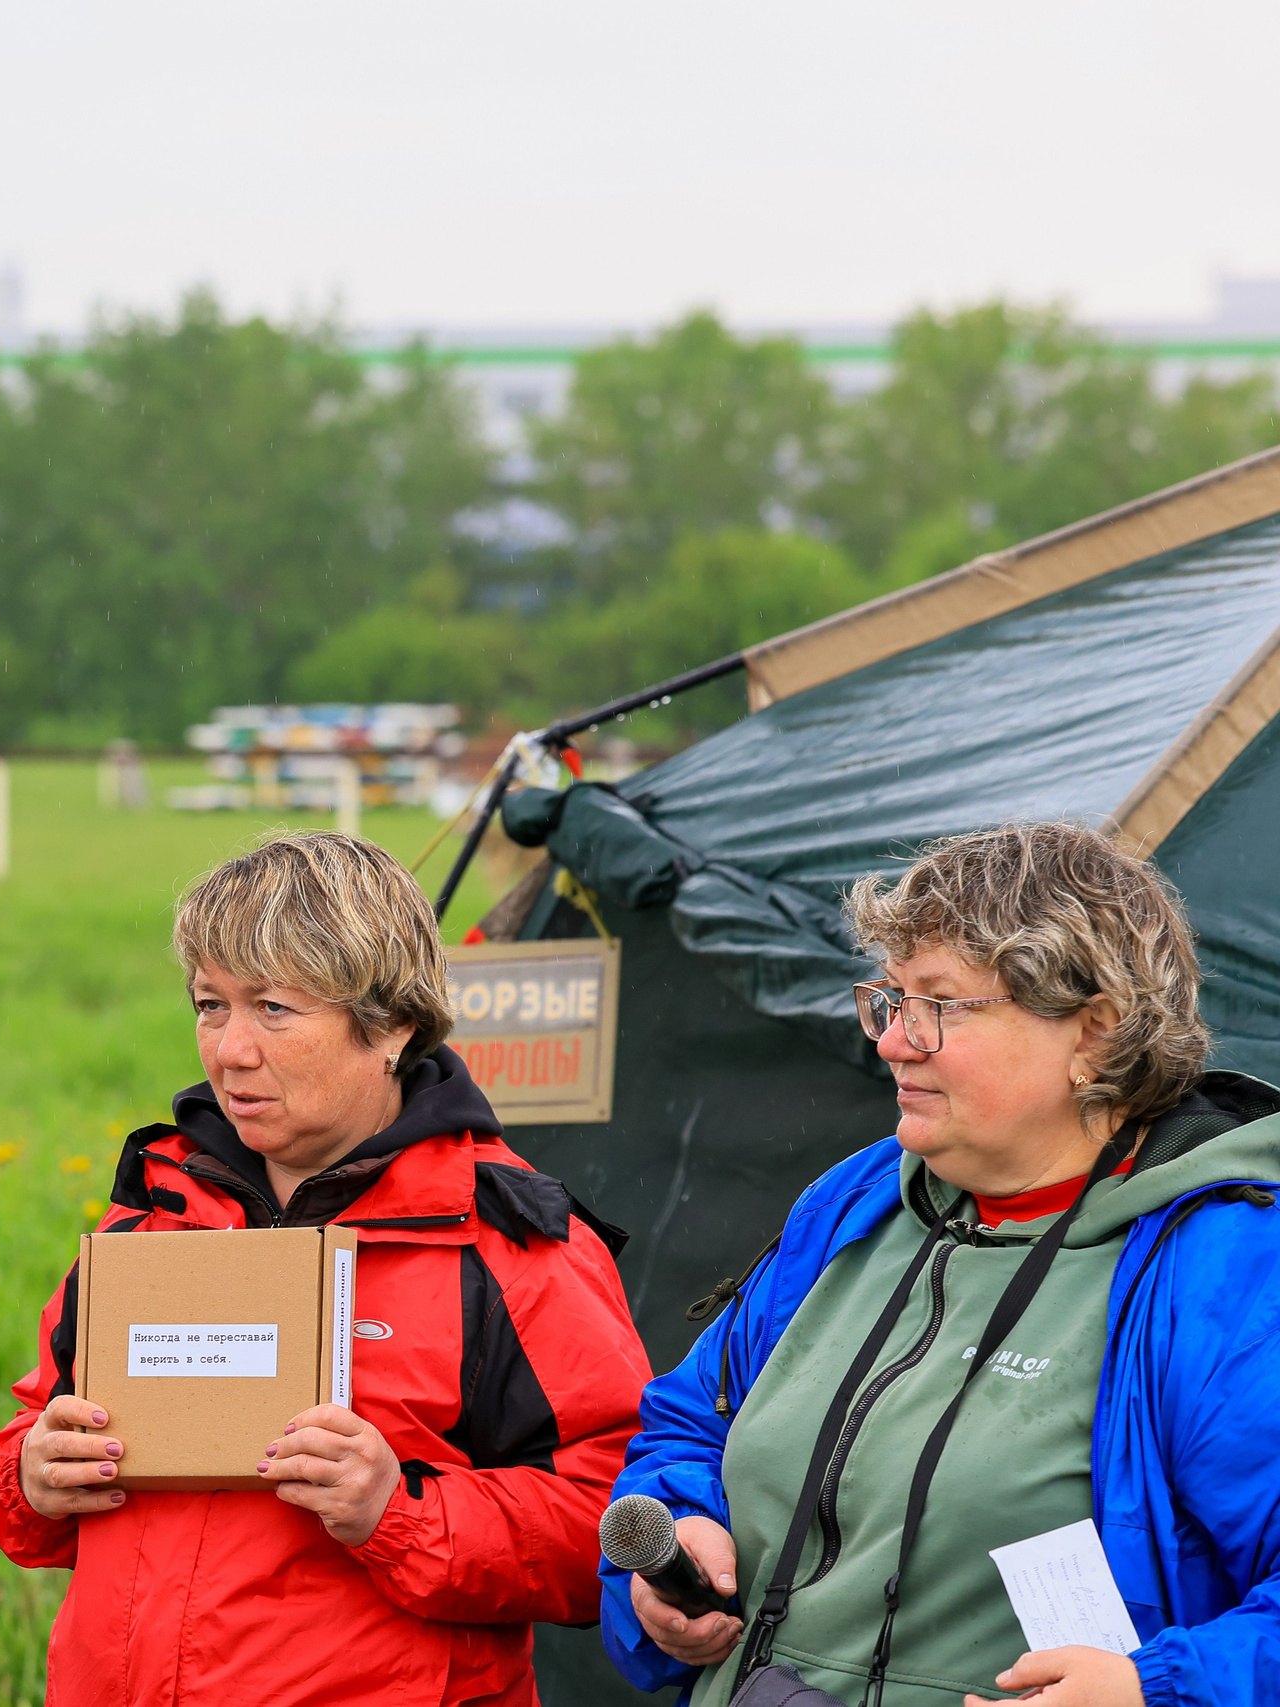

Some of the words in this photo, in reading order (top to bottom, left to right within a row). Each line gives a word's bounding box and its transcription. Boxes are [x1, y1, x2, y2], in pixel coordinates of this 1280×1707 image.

[447, 1038, 582, 1088] ОРОДЫ
[134, 1332, 181, 1345] Никогда
[187, 1334, 201, 1342] не
[207, 1331, 275, 1345] переставай
[140, 1355, 180, 1366] верить
[186, 1355, 194, 1364] в
[200, 1353, 232, 1364] себя.
